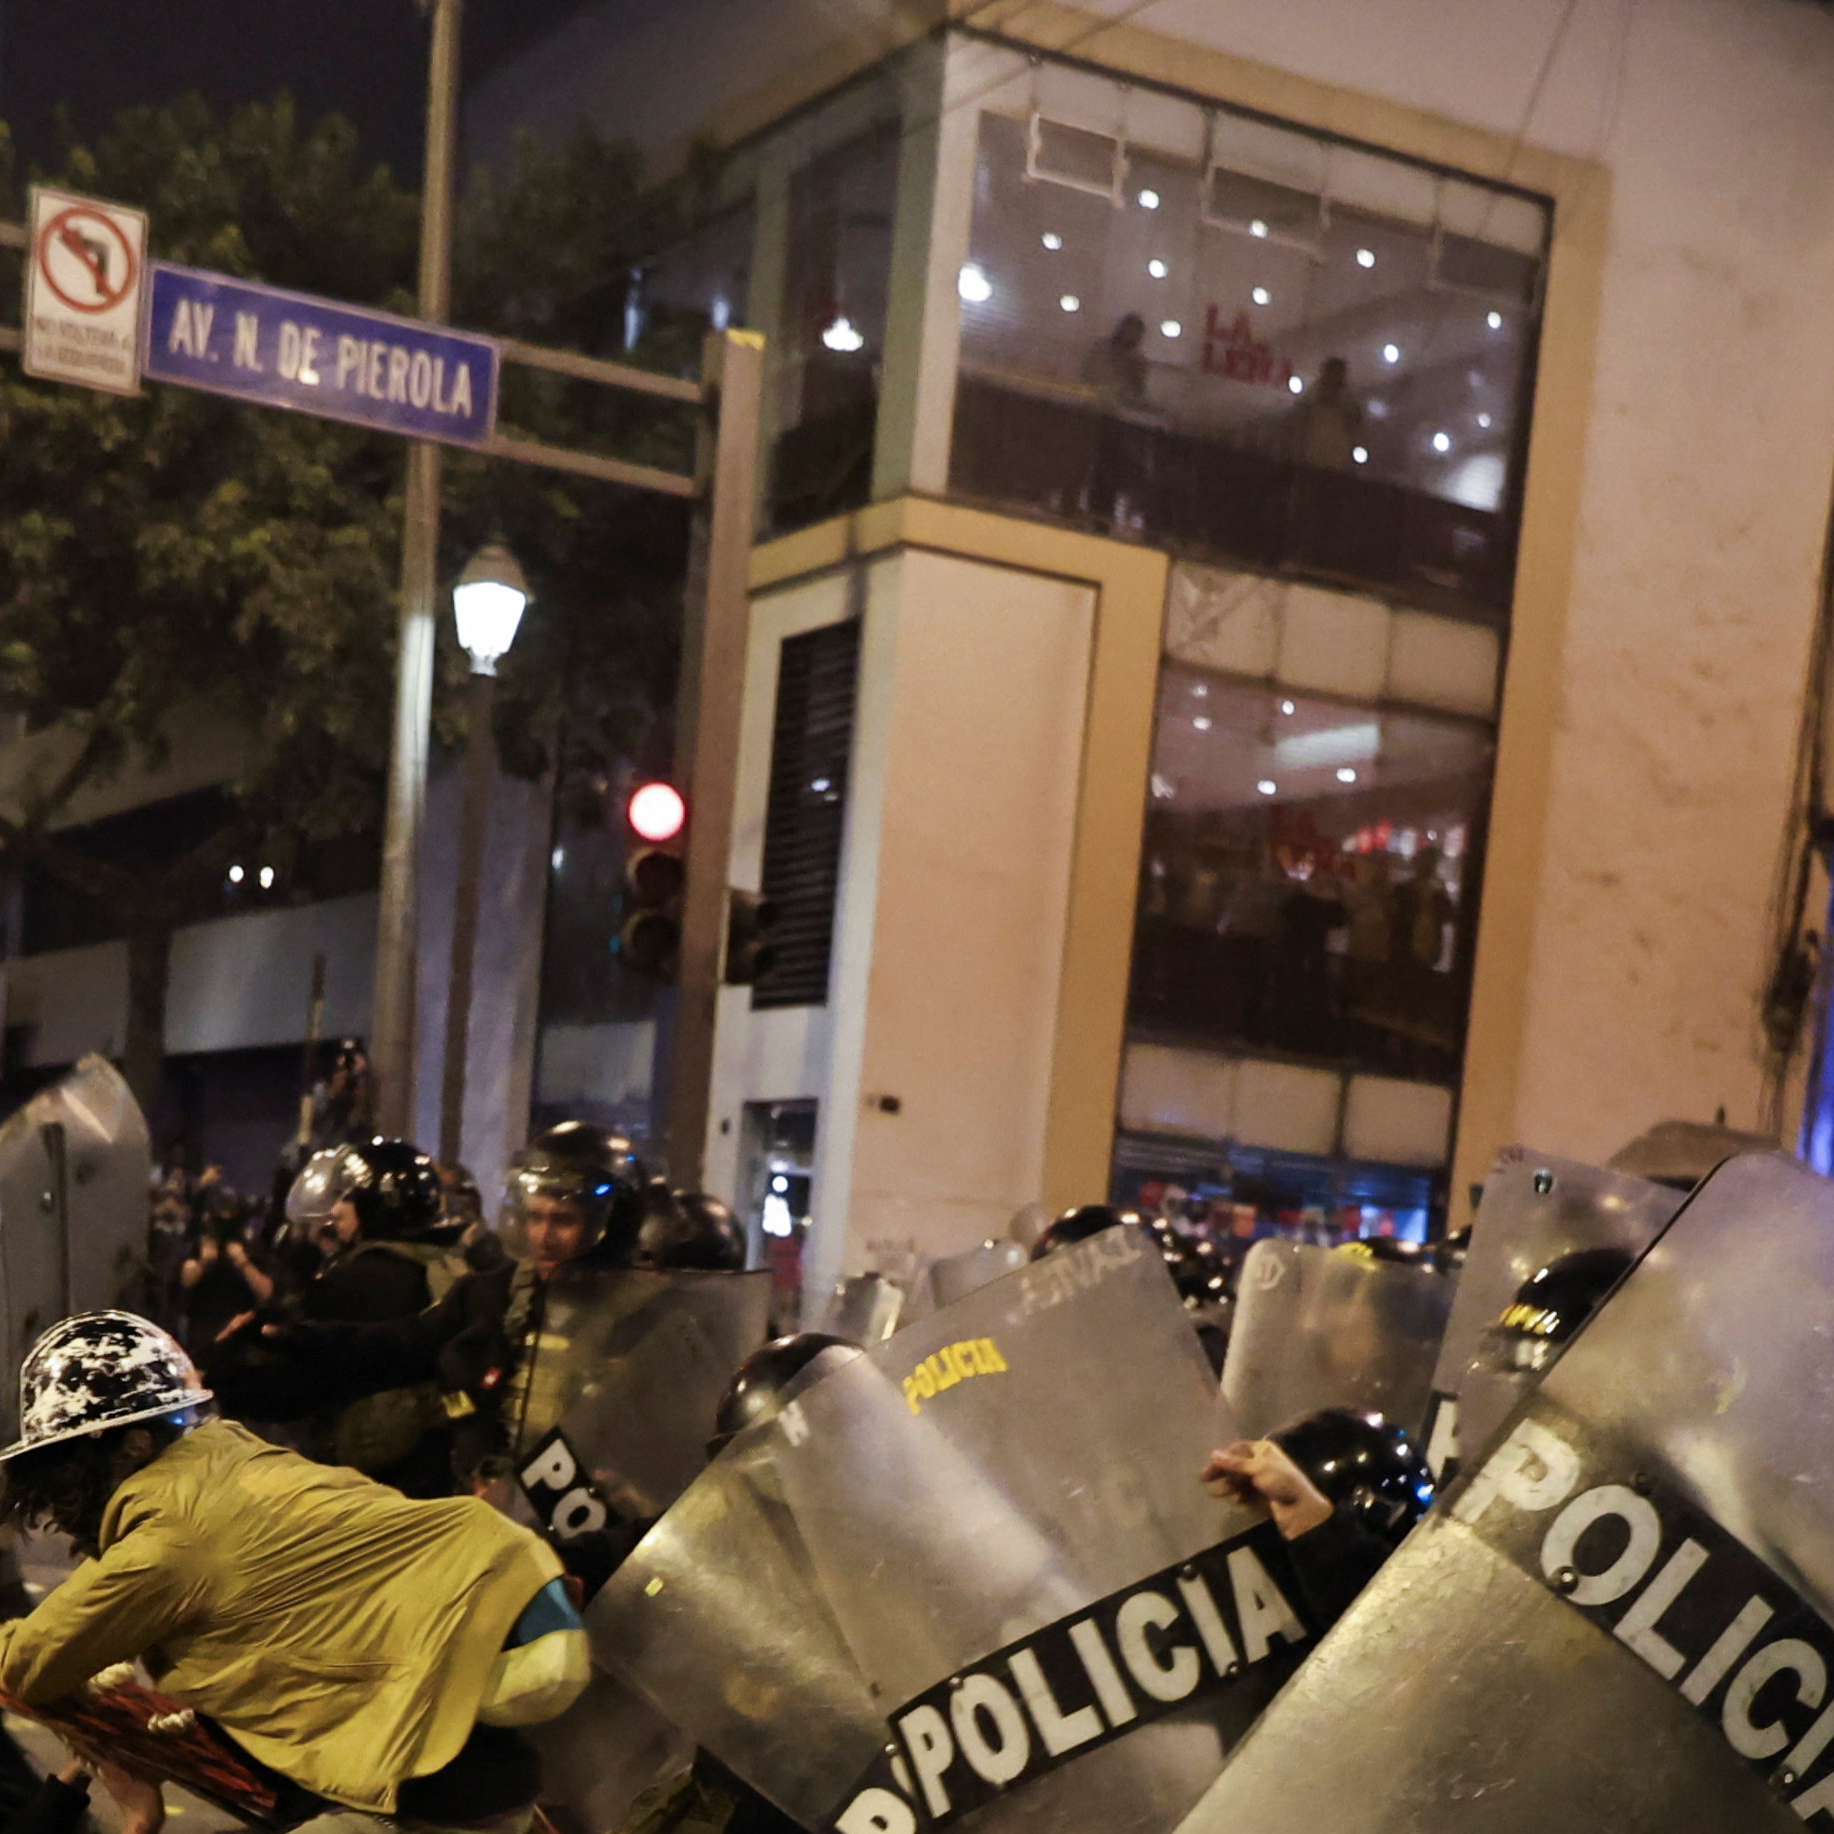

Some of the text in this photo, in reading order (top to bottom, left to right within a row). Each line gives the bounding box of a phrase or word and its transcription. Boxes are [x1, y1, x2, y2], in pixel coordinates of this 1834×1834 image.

[169, 297, 219, 361] AV.
[233, 311, 263, 372] N.
[276, 320, 322, 386] DE
[337, 333, 473, 419] PIEROLA
[903, 1337, 1009, 1415] POLICIA
[898, 1545, 1308, 1820] POLICIA
